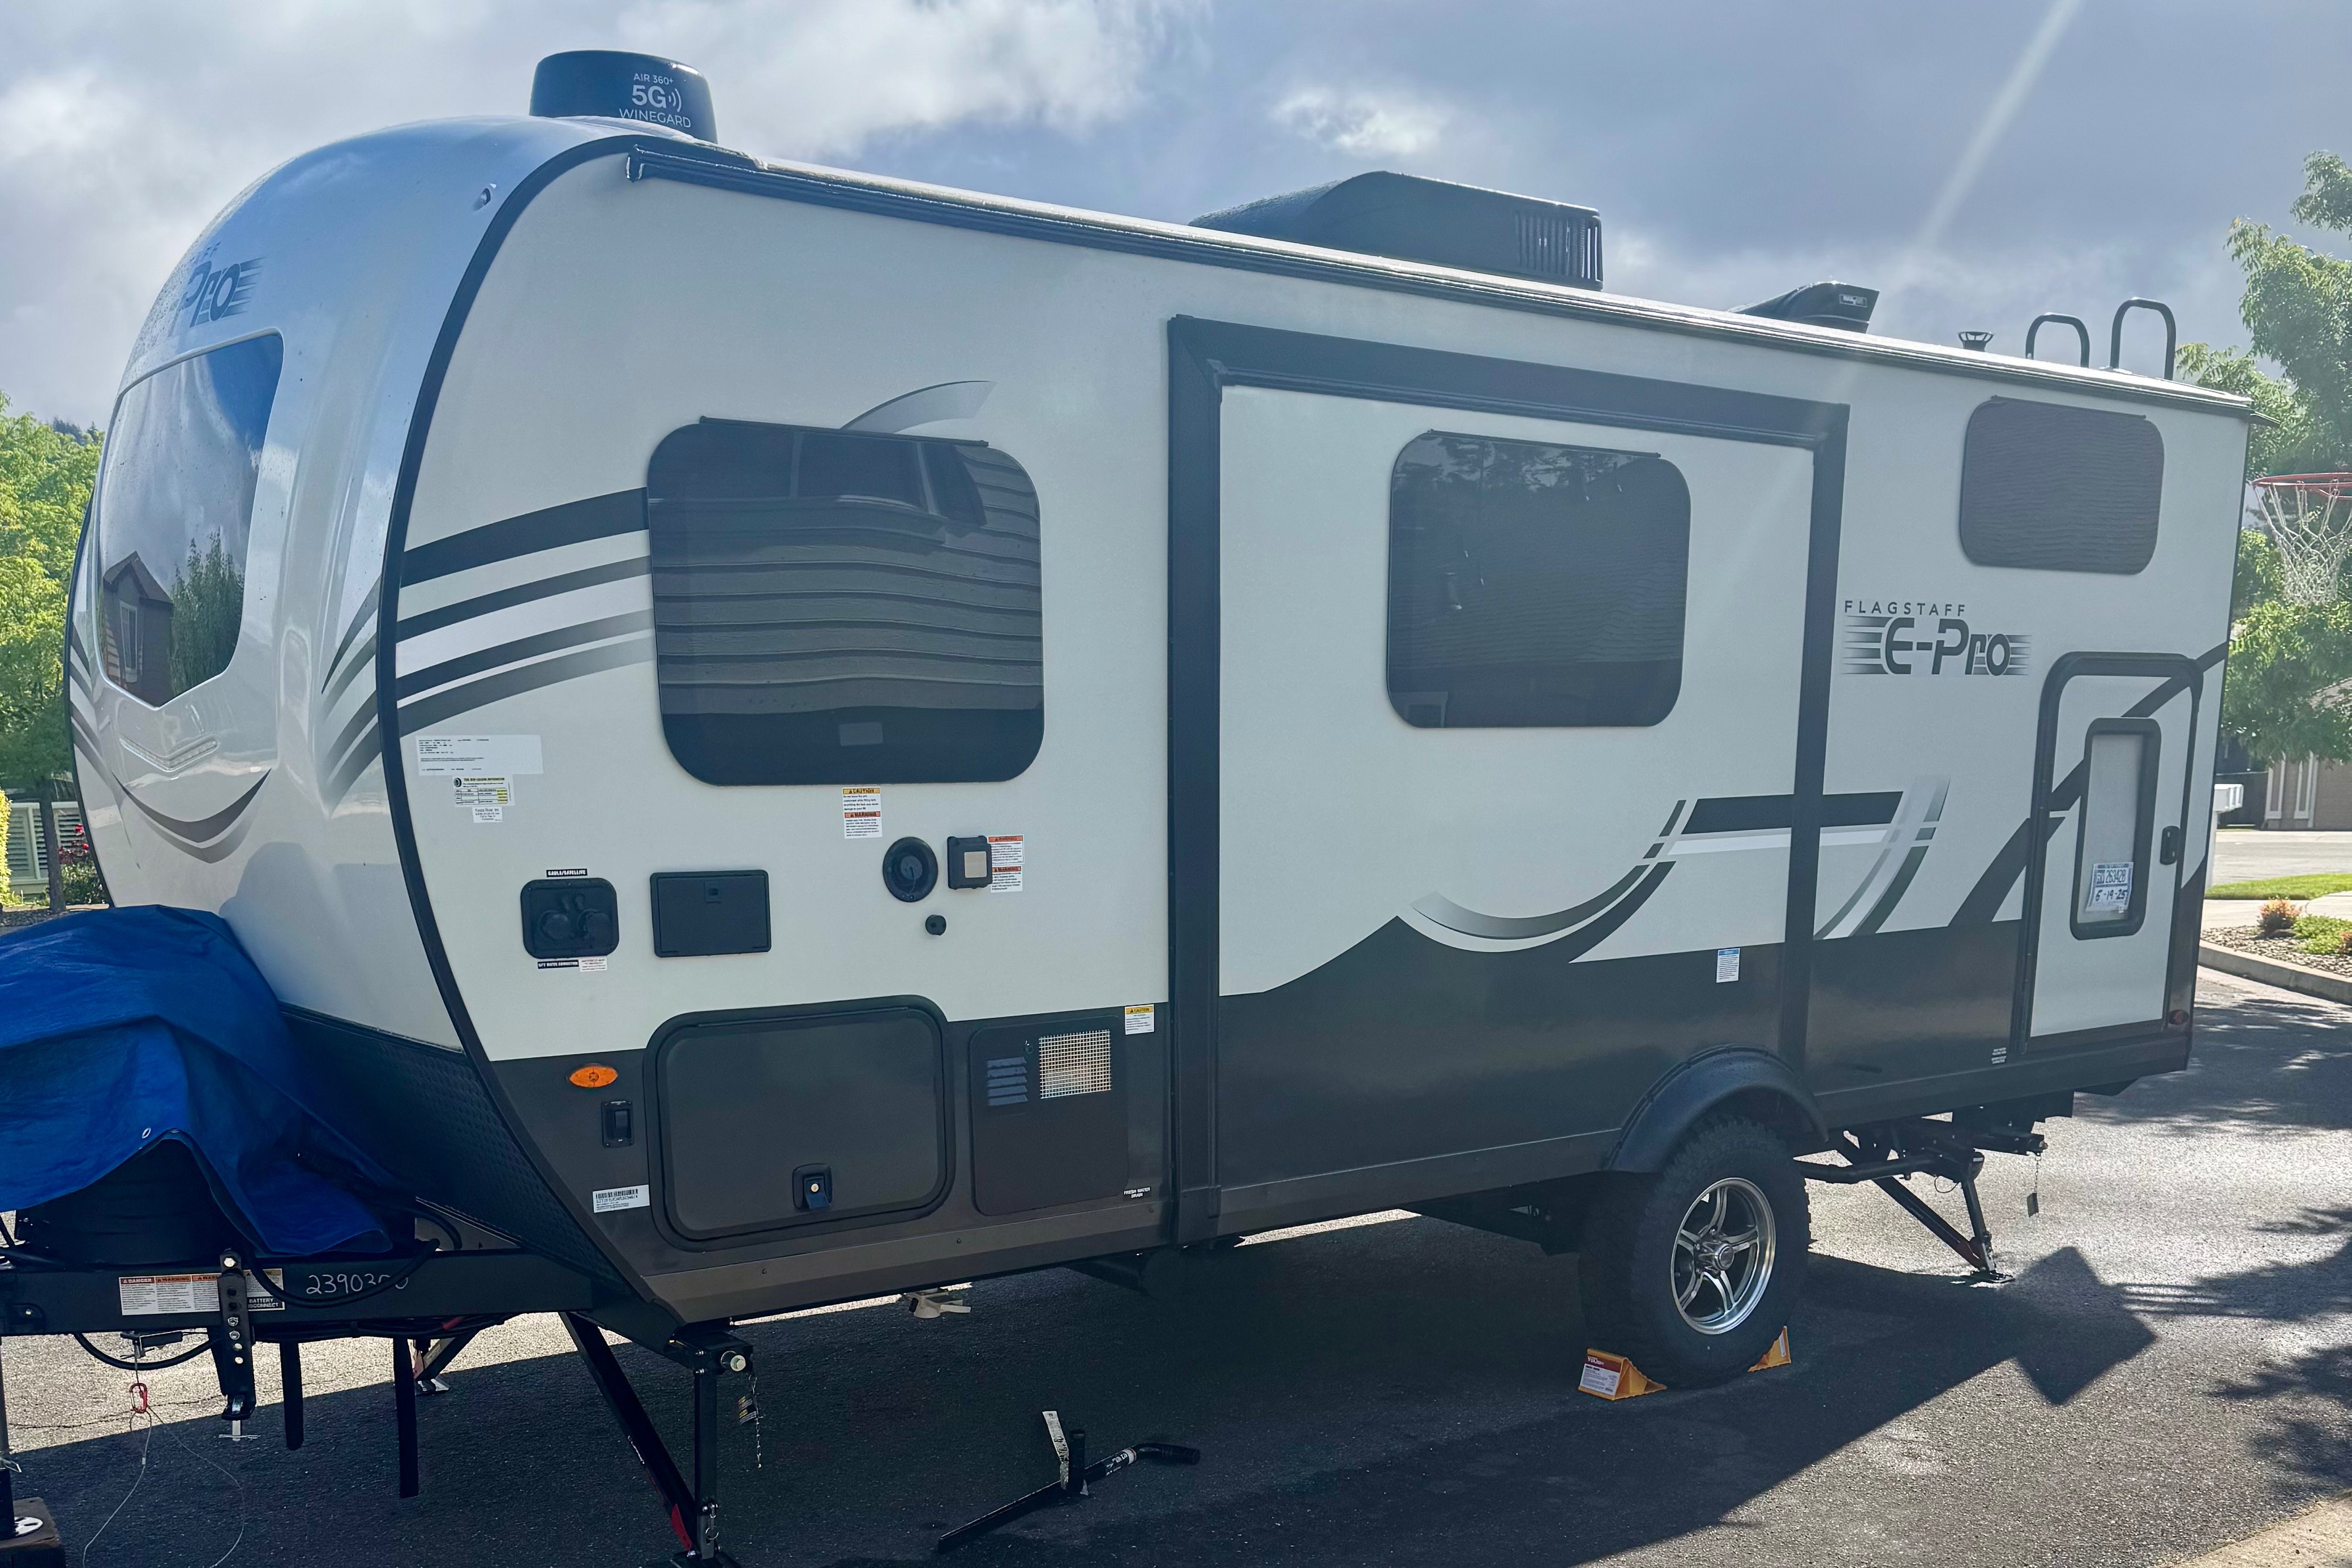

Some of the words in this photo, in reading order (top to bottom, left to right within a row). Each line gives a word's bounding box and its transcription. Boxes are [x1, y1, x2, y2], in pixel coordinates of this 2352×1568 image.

[633, 73, 650, 83] AIR
[631, 85, 667, 108] 5G
[619, 108, 692, 128] WINEGARD
[1844, 600, 1965, 616] FLAGSTAFF
[1884, 617, 2011, 676] E-Pro
[2105, 869, 2126, 884] 263428
